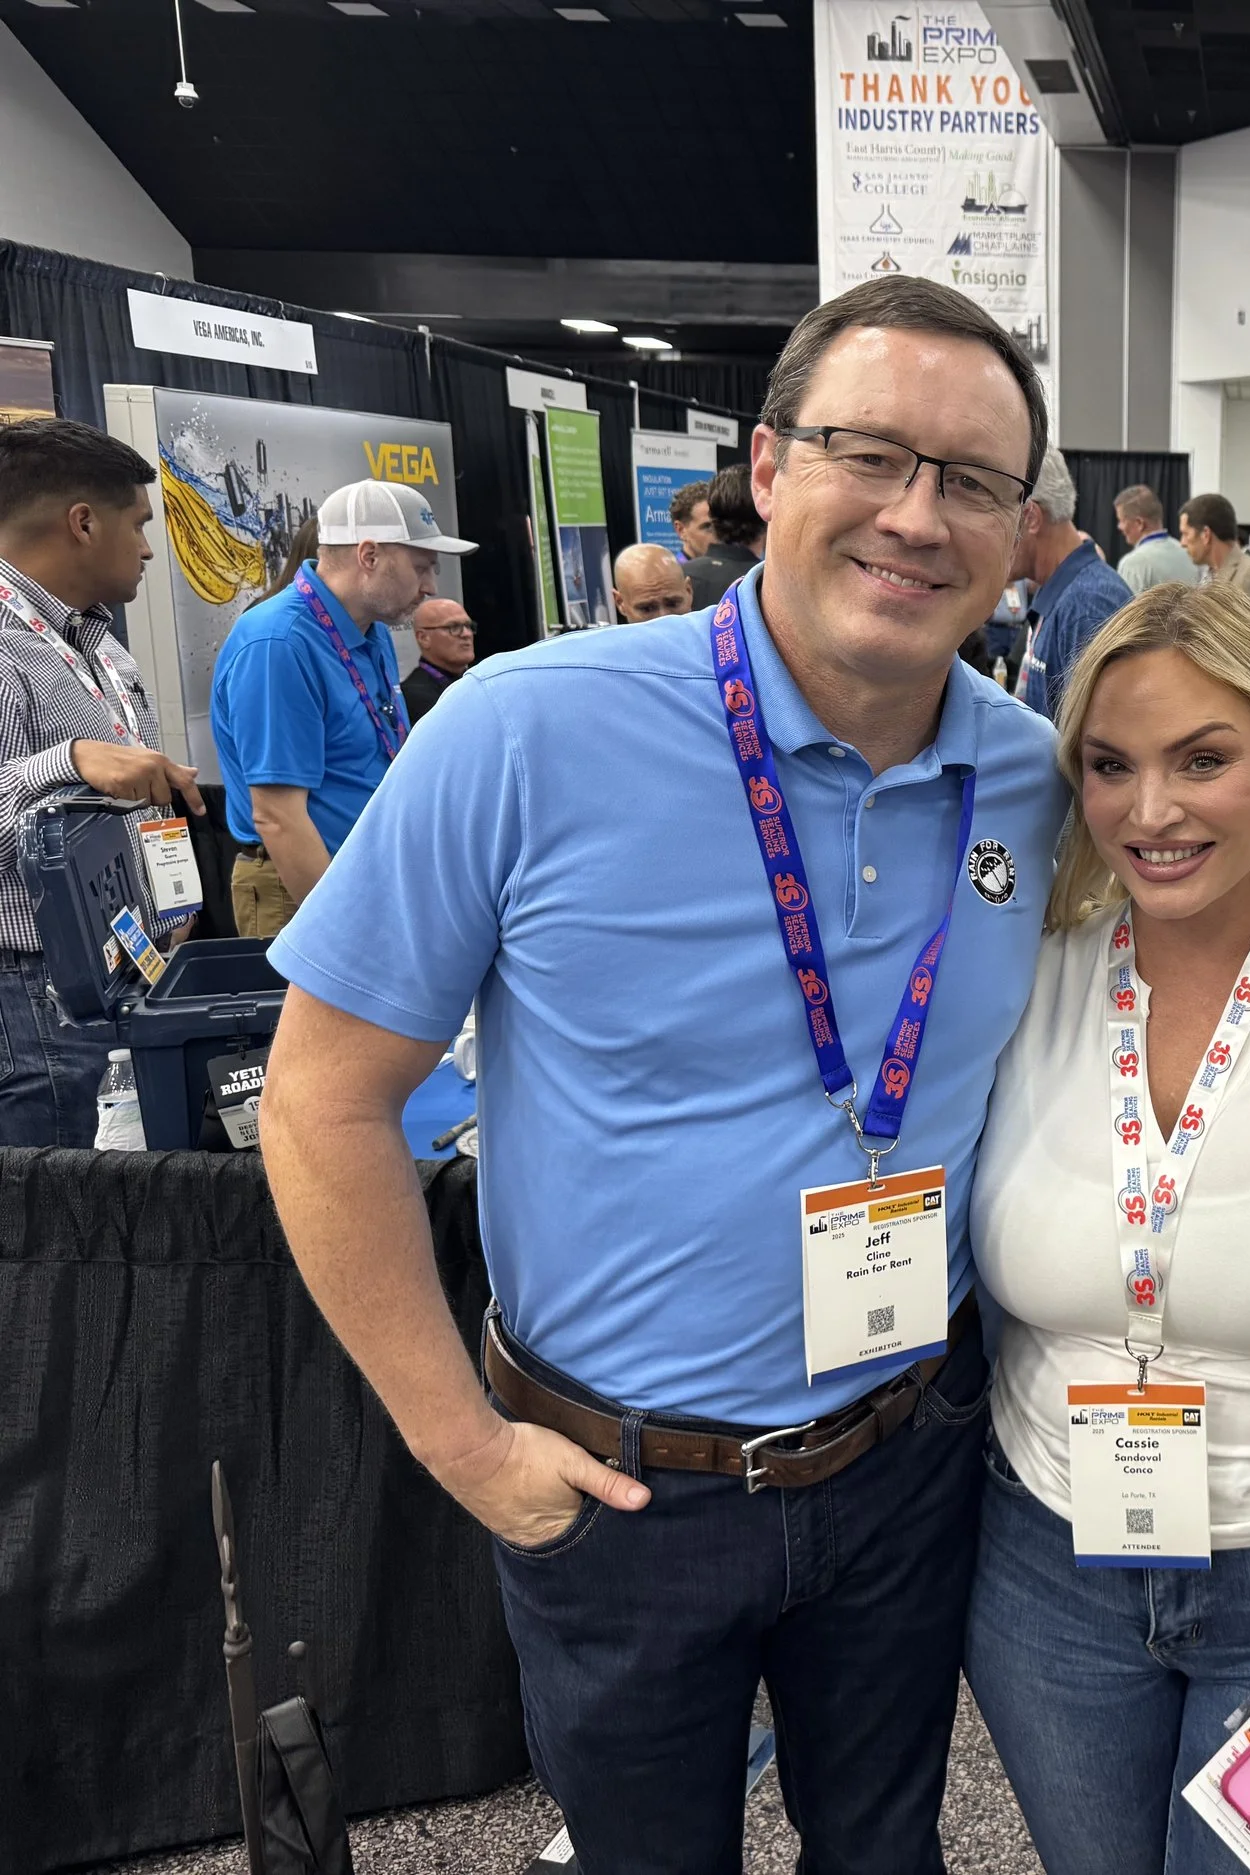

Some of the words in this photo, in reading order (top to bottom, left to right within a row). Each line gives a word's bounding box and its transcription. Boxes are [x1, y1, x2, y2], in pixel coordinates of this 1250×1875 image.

[923, 15, 957, 25] THE
[923, 27, 1000, 46] PRIM
[923, 46, 997, 64] EXPO
[840, 72, 953, 105] THANK
[838, 107, 934, 134] INDUSTRY
[940, 110, 1041, 135] PARTNERS
[846, 142, 868, 154] East
[870, 143, 903, 156] Harris
[905, 144, 942, 158] County
[948, 150, 984, 165] Making
[864, 182, 927, 196] COLLEGE
[973, 231, 1038, 241] MARKETPLACE
[193, 319, 212, 339] VEGA
[214, 323, 250, 347] AMERICAS,
[250, 330, 265, 347] INC.
[363, 440, 439, 485] VEGA
[646, 505, 672, 523] Arma
[716, 633, 726, 668] SERVICES
[722, 631, 732, 662] SEALING
[728, 628, 739, 665] SUPERIOR
[724, 678, 748, 709] 3S
[732, 722, 749, 762] SERVICES
[740, 720, 755, 757] SEALING
[748, 719, 764, 760] SUPERIOR
[749, 776, 774, 807] 3S
[759, 819, 775, 860] SERVICES
[766, 817, 781, 854] SEALING
[773, 816, 790, 857] SUPERIOR
[980, 840, 999, 851] FOR
[968, 851, 979, 881] RAIN
[1003, 851, 1016, 883] RENT
[774, 872, 800, 903] 3S
[783, 915, 799, 956] SERVICES
[790, 914, 804, 950] SEALING
[797, 912, 813, 953] SUPERIOR
[797, 968, 819, 997] 3S
[911, 976, 930, 1007] 3S
[1116, 989, 1135, 1011] 3S
[809, 1009, 824, 1049] SERVICES
[814, 1007, 827, 1043] SEALING
[819, 1006, 834, 1045] SUPERIOR
[893, 1018, 909, 1057] SUPERIOR
[900, 1023, 914, 1058] SEALING
[907, 1021, 921, 1060] SERVICES
[1209, 1040, 1231, 1066] 3S
[228, 1065, 264, 1082] YETI
[1119, 1053, 1138, 1078] 3S
[220, 1076, 266, 1096] ROAD
[885, 1068, 906, 1101] 3S
[1181, 1104, 1203, 1131] 3S
[1121, 1119, 1141, 1146] 3S
[925, 1195, 940, 1207] CAT
[1154, 1174, 1176, 1205] 3S
[831, 1210, 865, 1224] PRIME
[873, 1217, 912, 1231] REGISTRATION
[912, 1212, 938, 1223] SPONSOR
[1125, 1195, 1146, 1225] 3S
[831, 1219, 860, 1231] EXPO
[832, 1232, 845, 1240] 2025
[865, 1231, 891, 1248] Jeff
[846, 1267, 869, 1280] Rain
[872, 1263, 888, 1273] for
[890, 1257, 913, 1270] Rent
[866, 1250, 892, 1262] Cline
[1134, 1278, 1155, 1307] 3S
[859, 1340, 903, 1357] EXHIBITOR
[1184, 1412, 1199, 1423] CAT
[1114, 1452, 1162, 1462] Sandoval
[1115, 1437, 1160, 1449] Cassie
[1123, 1466, 1153, 1474] Conco
[1130, 1492, 1147, 1500] Porte,
